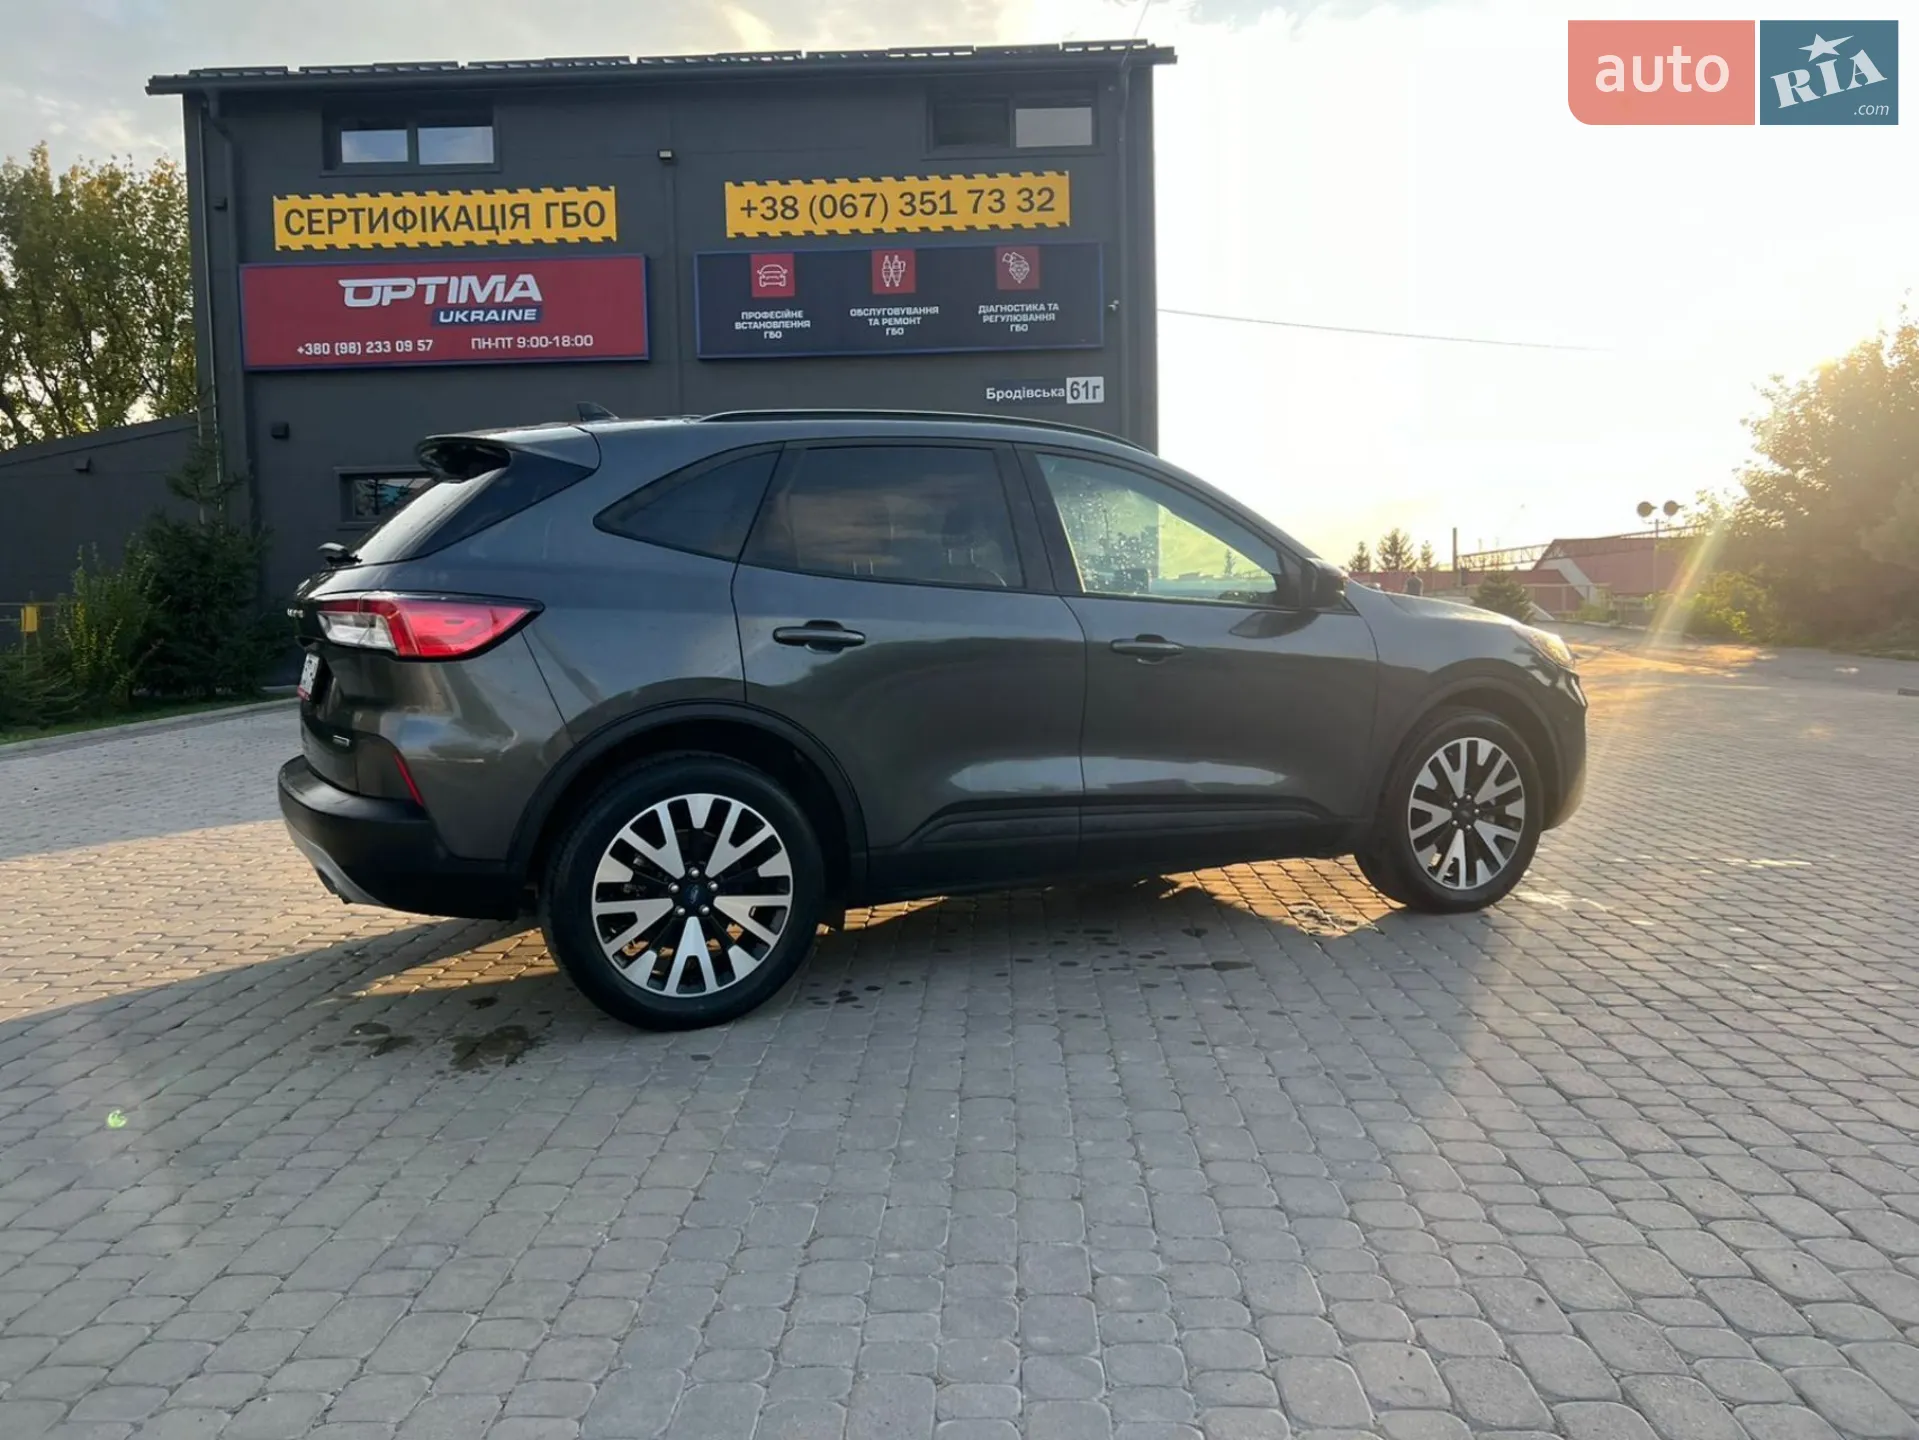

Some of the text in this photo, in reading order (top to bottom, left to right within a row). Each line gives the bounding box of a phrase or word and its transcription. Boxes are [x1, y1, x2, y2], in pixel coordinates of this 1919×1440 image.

[740, 186, 1055, 225] +38 (067) 351 73 32
[284, 200, 606, 236] СЕРТИФІКАЦІЯ ГБО
[338, 273, 543, 308] OPTIMA
[741, 309, 804, 320] ПРОФЕСІЙНЕ
[849, 306, 940, 317] ОБСЛУГОВУВАННЯ
[978, 303, 1060, 315] ДІАГНОСТИКА ТА
[439, 309, 538, 324] UKRAINE
[868, 316, 922, 327] ТА РЕМОНТ
[982, 313, 1056, 323] РЕГУЛЮВАННЯ
[734, 320, 812, 330] ВСТАНОВЛЕННЯ
[1010, 323, 1029, 332] ГБО
[763, 330, 783, 339] ГБО
[885, 327, 905, 336] ГБО
[297, 339, 434, 356] +380 (98) 233 09 57
[471, 334, 594, 350] ПН-ПТ 9:00-18:00
[986, 380, 1101, 402] Бродівська 61г
